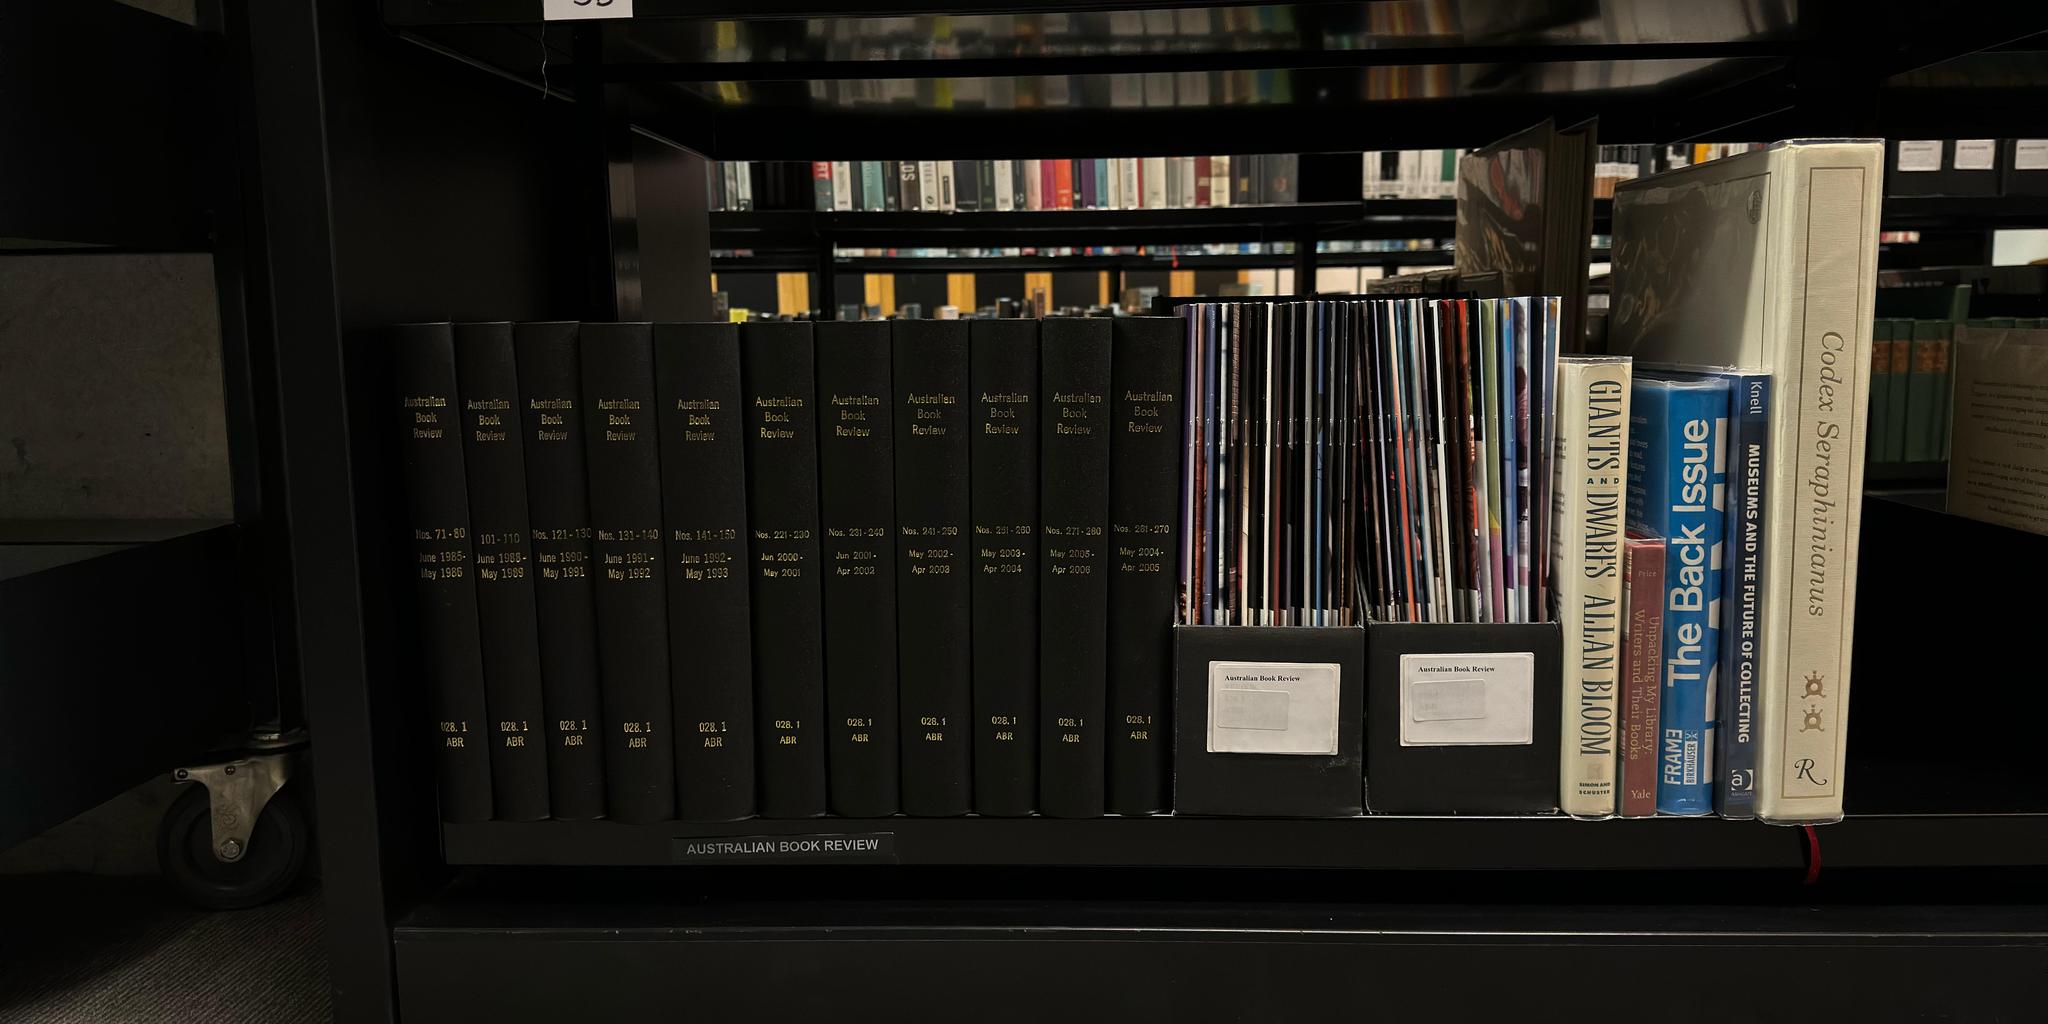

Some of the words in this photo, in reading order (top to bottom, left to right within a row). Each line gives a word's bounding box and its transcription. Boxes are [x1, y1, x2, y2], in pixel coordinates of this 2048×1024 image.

[1818, 330, 1845, 412] Codex
[404, 396, 446, 408] Australian
[755, 396, 803, 408] Australian
[831, 394, 880, 406] Australian
[907, 392, 956, 405] Australian
[980, 392, 1030, 404] Australian
[1052, 392, 1102, 404] Australian
[1124, 390, 1173, 402] Australian
[1750, 381, 1763, 415] Knell
[467, 399, 510, 410] Australian
[530, 398, 572, 410] Australian
[598, 398, 640, 410] Australian
[677, 399, 720, 410] Australian
[764, 411, 790, 423] Book
[840, 410, 866, 421] Book
[917, 408, 942, 420] Book
[990, 408, 1016, 419] Book
[1062, 407, 1088, 419] Book
[1134, 406, 1159, 417] Book
[416, 412, 438, 424] Book
[478, 414, 501, 426] Book
[541, 414, 563, 425] Book
[608, 414, 631, 426] Book
[688, 414, 711, 426] Book
[836, 425, 871, 438] Review
[912, 424, 947, 436] Review
[985, 423, 1020, 436] Review
[1056, 423, 1092, 436] Review
[1128, 422, 1163, 434] Review
[1586, 380, 1622, 471] GIANTS
[413, 428, 443, 440] Review
[476, 430, 506, 442] Review
[538, 430, 568, 441] Review
[606, 430, 636, 442] Review
[685, 430, 716, 442] Review
[760, 428, 794, 440] Review
[1672, 419, 1710, 512] Issue
[1746, 444, 1760, 520] MUSEUMS
[1807, 420, 1840, 618] Seraphinianus
[598, 530, 616, 541] Nos.
[674, 530, 693, 542] Nos.
[755, 530, 771, 540] Nos.
[828, 528, 846, 538] Nos.
[902, 526, 919, 536] Nos.
[976, 526, 992, 534] Nos.
[1046, 526, 1063, 535] Nos.
[1584, 490, 1619, 579] DWARFS
[1744, 522, 1759, 554] AND
[418, 552, 437, 564] June
[477, 552, 496, 564] June
[538, 552, 556, 563] June
[760, 552, 774, 562] Jun
[835, 551, 850, 560] Jun
[908, 548, 924, 559] May
[980, 548, 997, 558] May
[1050, 548, 1066, 559] May
[1119, 546, 1136, 558] May
[604, 553, 623, 564] June
[680, 553, 700, 564] June
[763, 568, 780, 578] May
[836, 566, 850, 576] Apr
[911, 564, 926, 574] Apr
[983, 564, 998, 574] Apr
[1052, 564, 1066, 575] Apr
[1120, 562, 1136, 572] Apr
[1669, 523, 1706, 612] Back
[1744, 555, 1758, 582] THE
[421, 568, 437, 580] May
[481, 568, 498, 581] May
[542, 568, 560, 580] May
[608, 568, 625, 581] May
[686, 568, 704, 581] May
[1742, 584, 1756, 639] FUTURE
[1582, 594, 1616, 671] ALLAN
[1632, 609, 1646, 655] Writers
[1644, 616, 1660, 683] Unpacking
[1667, 622, 1703, 688] The
[1742, 642, 1754, 659] OF
[1632, 658, 1643, 683] and
[1224, 674, 1258, 682] Australian
[1260, 674, 1276, 682] Book
[1644, 686, 1658, 704] My
[1630, 686, 1644, 720] Their
[1738, 661, 1753, 744] COLLECTING
[1580, 678, 1614, 756] BLOOM
[506, 736, 524, 747] ABR
[564, 734, 584, 746] ABR
[779, 736, 797, 745] ABR
[851, 734, 870, 742] ABR
[925, 732, 943, 742] ABR
[995, 732, 1014, 740] ABR
[1062, 734, 1080, 743] ABR
[1130, 731, 1148, 740] ABR
[446, 736, 464, 748] ABR
[628, 737, 648, 748] ABR
[704, 737, 722, 748] ABR
[1630, 724, 1642, 761] Books
[1794, 758, 1828, 786] R
[1630, 790, 1651, 800] Yale
[686, 842, 776, 855] AUSTRALIAN
[779, 840, 821, 852] BOOK
[824, 838, 879, 852] REVIEW
